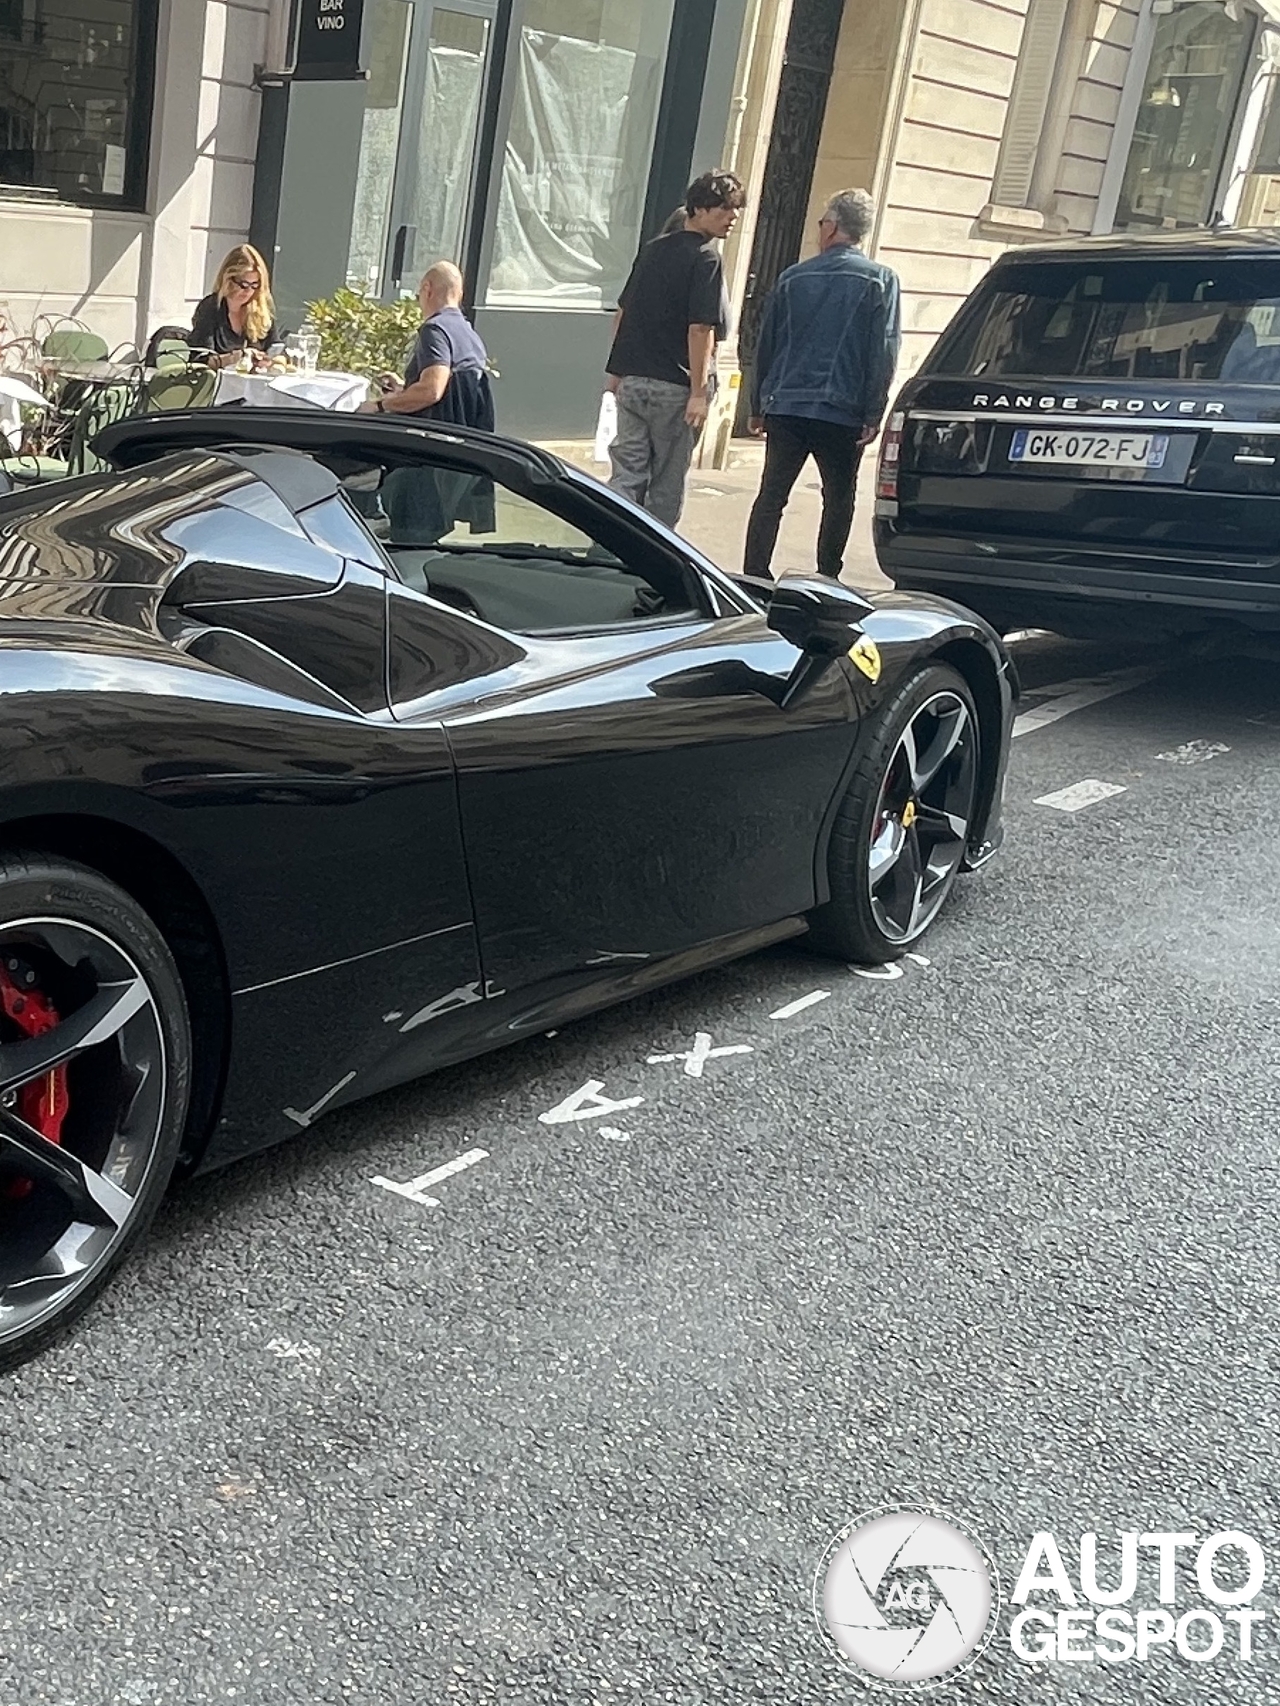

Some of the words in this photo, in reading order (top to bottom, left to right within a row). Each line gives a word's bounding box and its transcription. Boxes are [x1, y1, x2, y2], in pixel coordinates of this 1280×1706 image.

[320, 0, 344, 11] BAR
[317, 15, 345, 30] VINO
[972, 394, 1079, 409] RANGE
[1101, 399, 1226, 414] ROVER
[1029, 435, 1150, 462] GK-072-FJ
